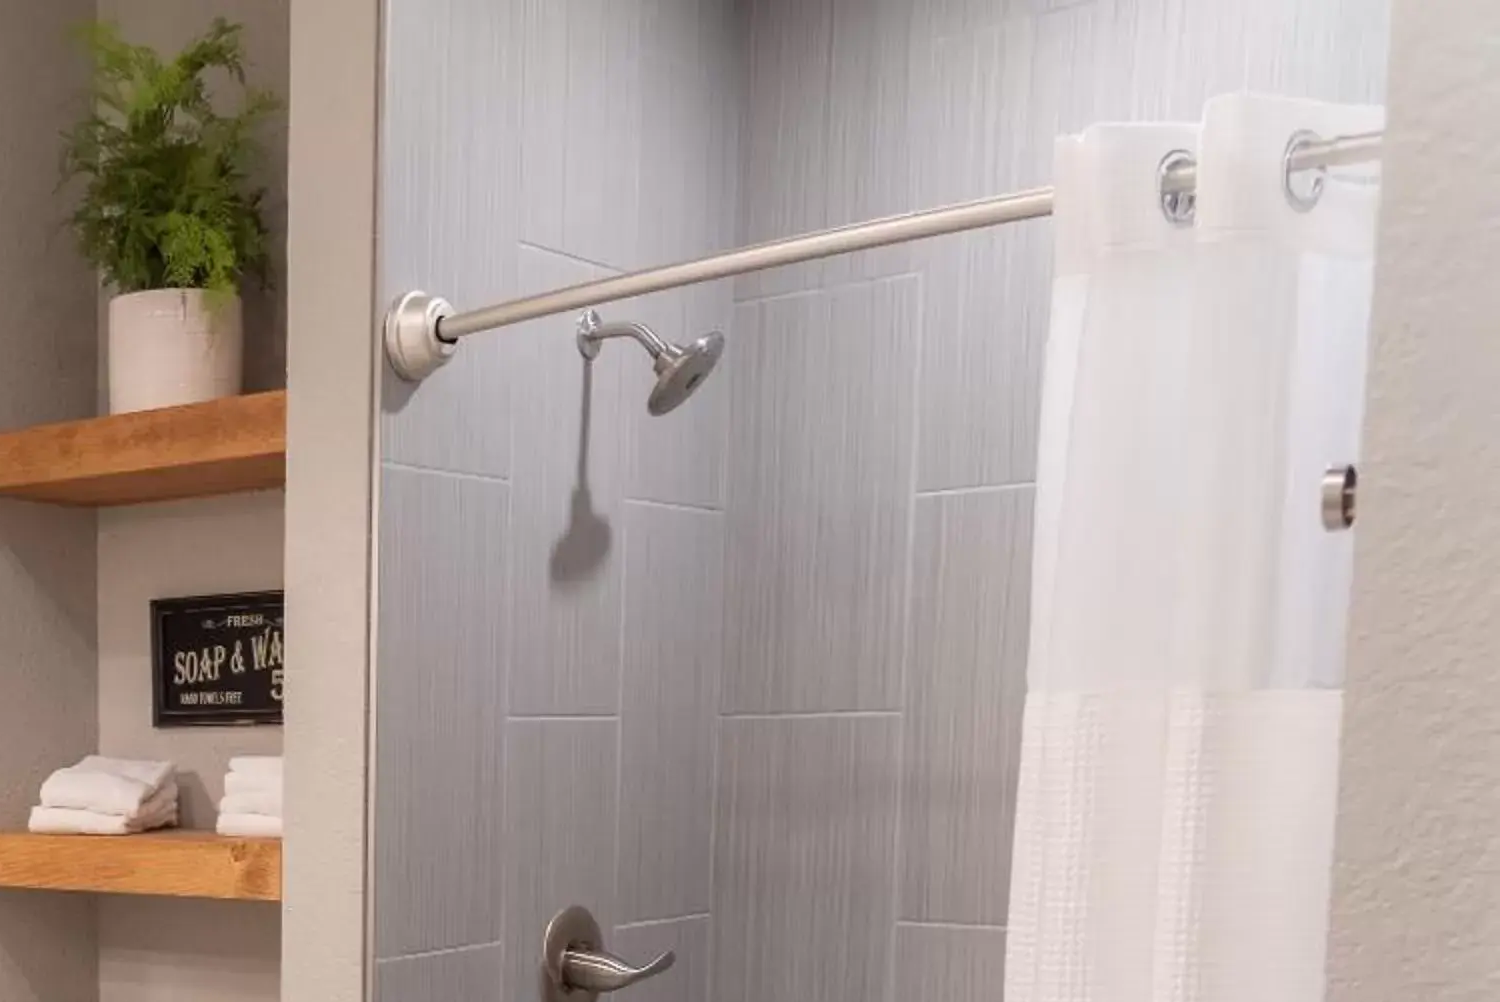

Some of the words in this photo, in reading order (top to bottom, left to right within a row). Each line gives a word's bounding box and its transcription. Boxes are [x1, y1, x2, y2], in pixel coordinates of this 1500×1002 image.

[227, 614, 263, 627] FRESH
[173, 645, 226, 685] SOAP
[230, 640, 245, 673] &
